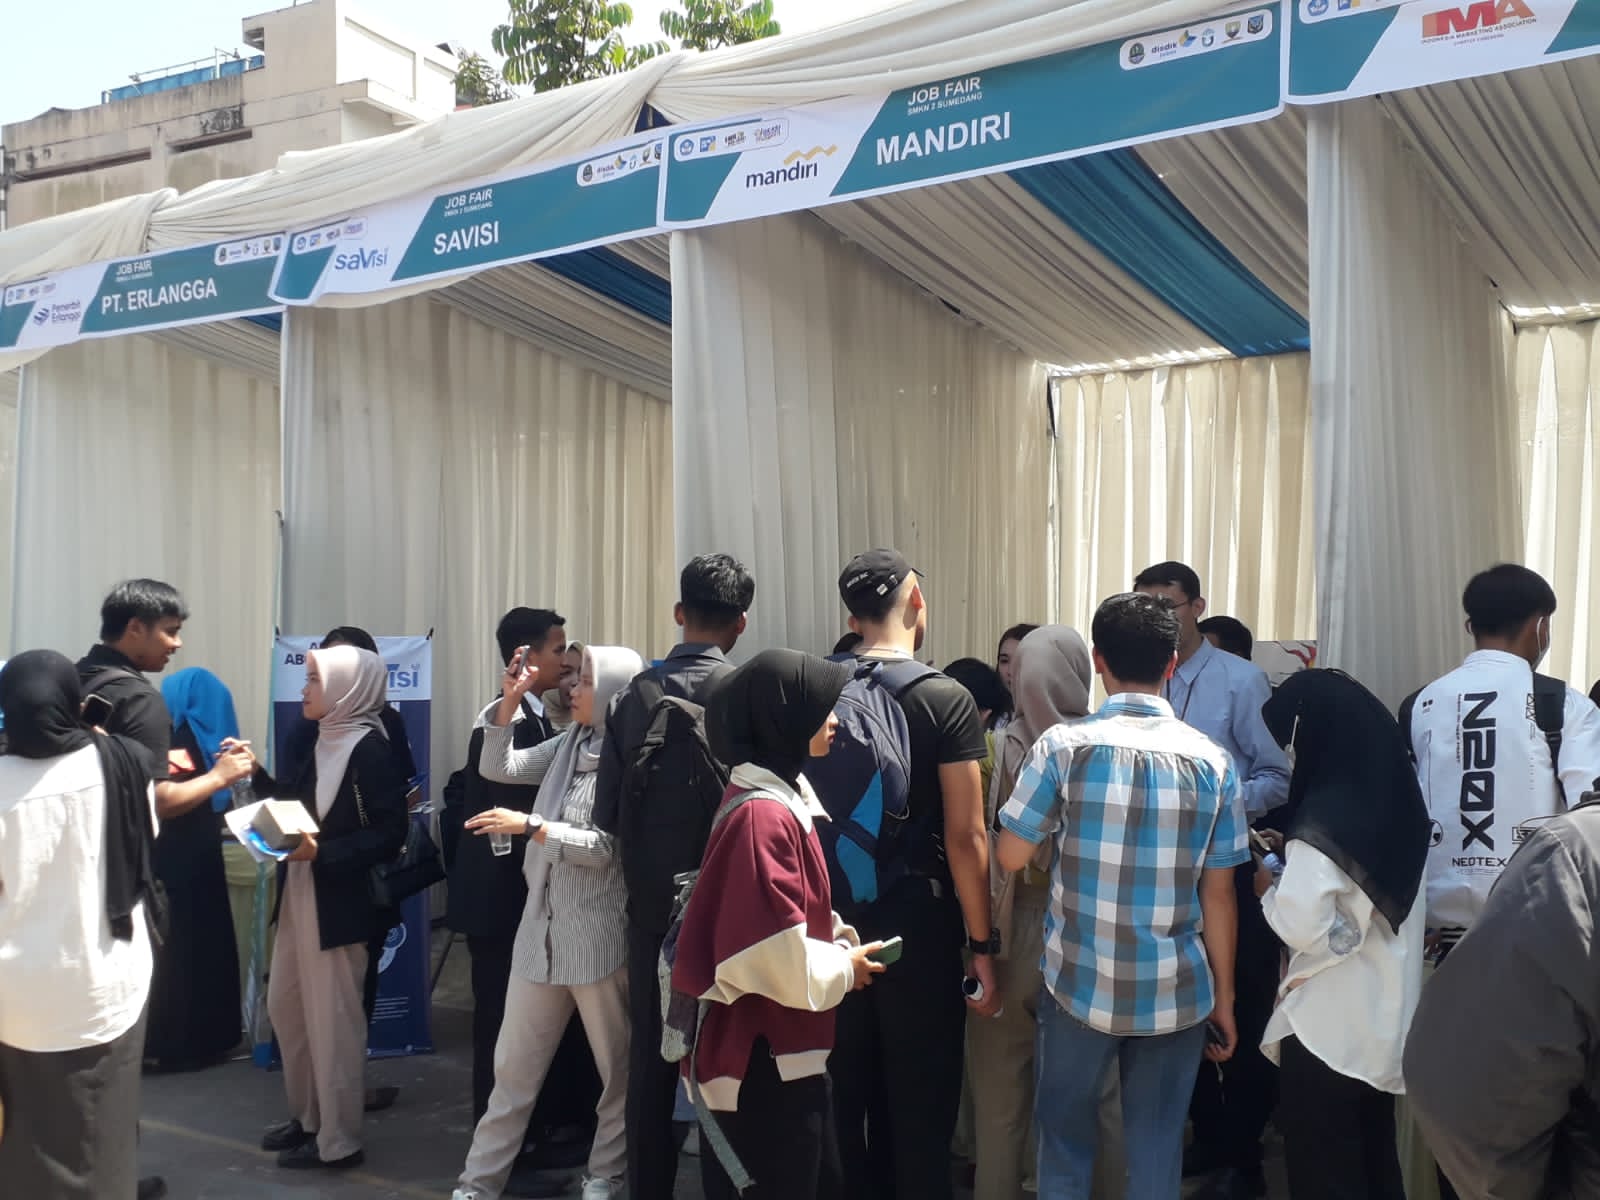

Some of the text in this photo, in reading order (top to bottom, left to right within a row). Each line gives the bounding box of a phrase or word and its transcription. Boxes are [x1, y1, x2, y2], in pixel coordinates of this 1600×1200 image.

[1455, 26, 1493, 39] MARKETING
[1494, 18, 1537, 32] ASSOCIATION
[1151, 41, 1178, 54] disdik
[907, 76, 981, 107] JOB FAIR
[907, 104, 930, 116] SMKN
[937, 91, 983, 109] SUMEDANG
[876, 111, 1011, 166] MANDIRI
[745, 160, 818, 188] mandiri
[444, 188, 493, 210] JOB FAIR
[433, 220, 500, 256] SAVISI
[116, 259, 152, 276] JOB FAIR
[101, 276, 218, 315] PT. ERLANGGA
[1452, 856, 1508, 868] NEOTEX
